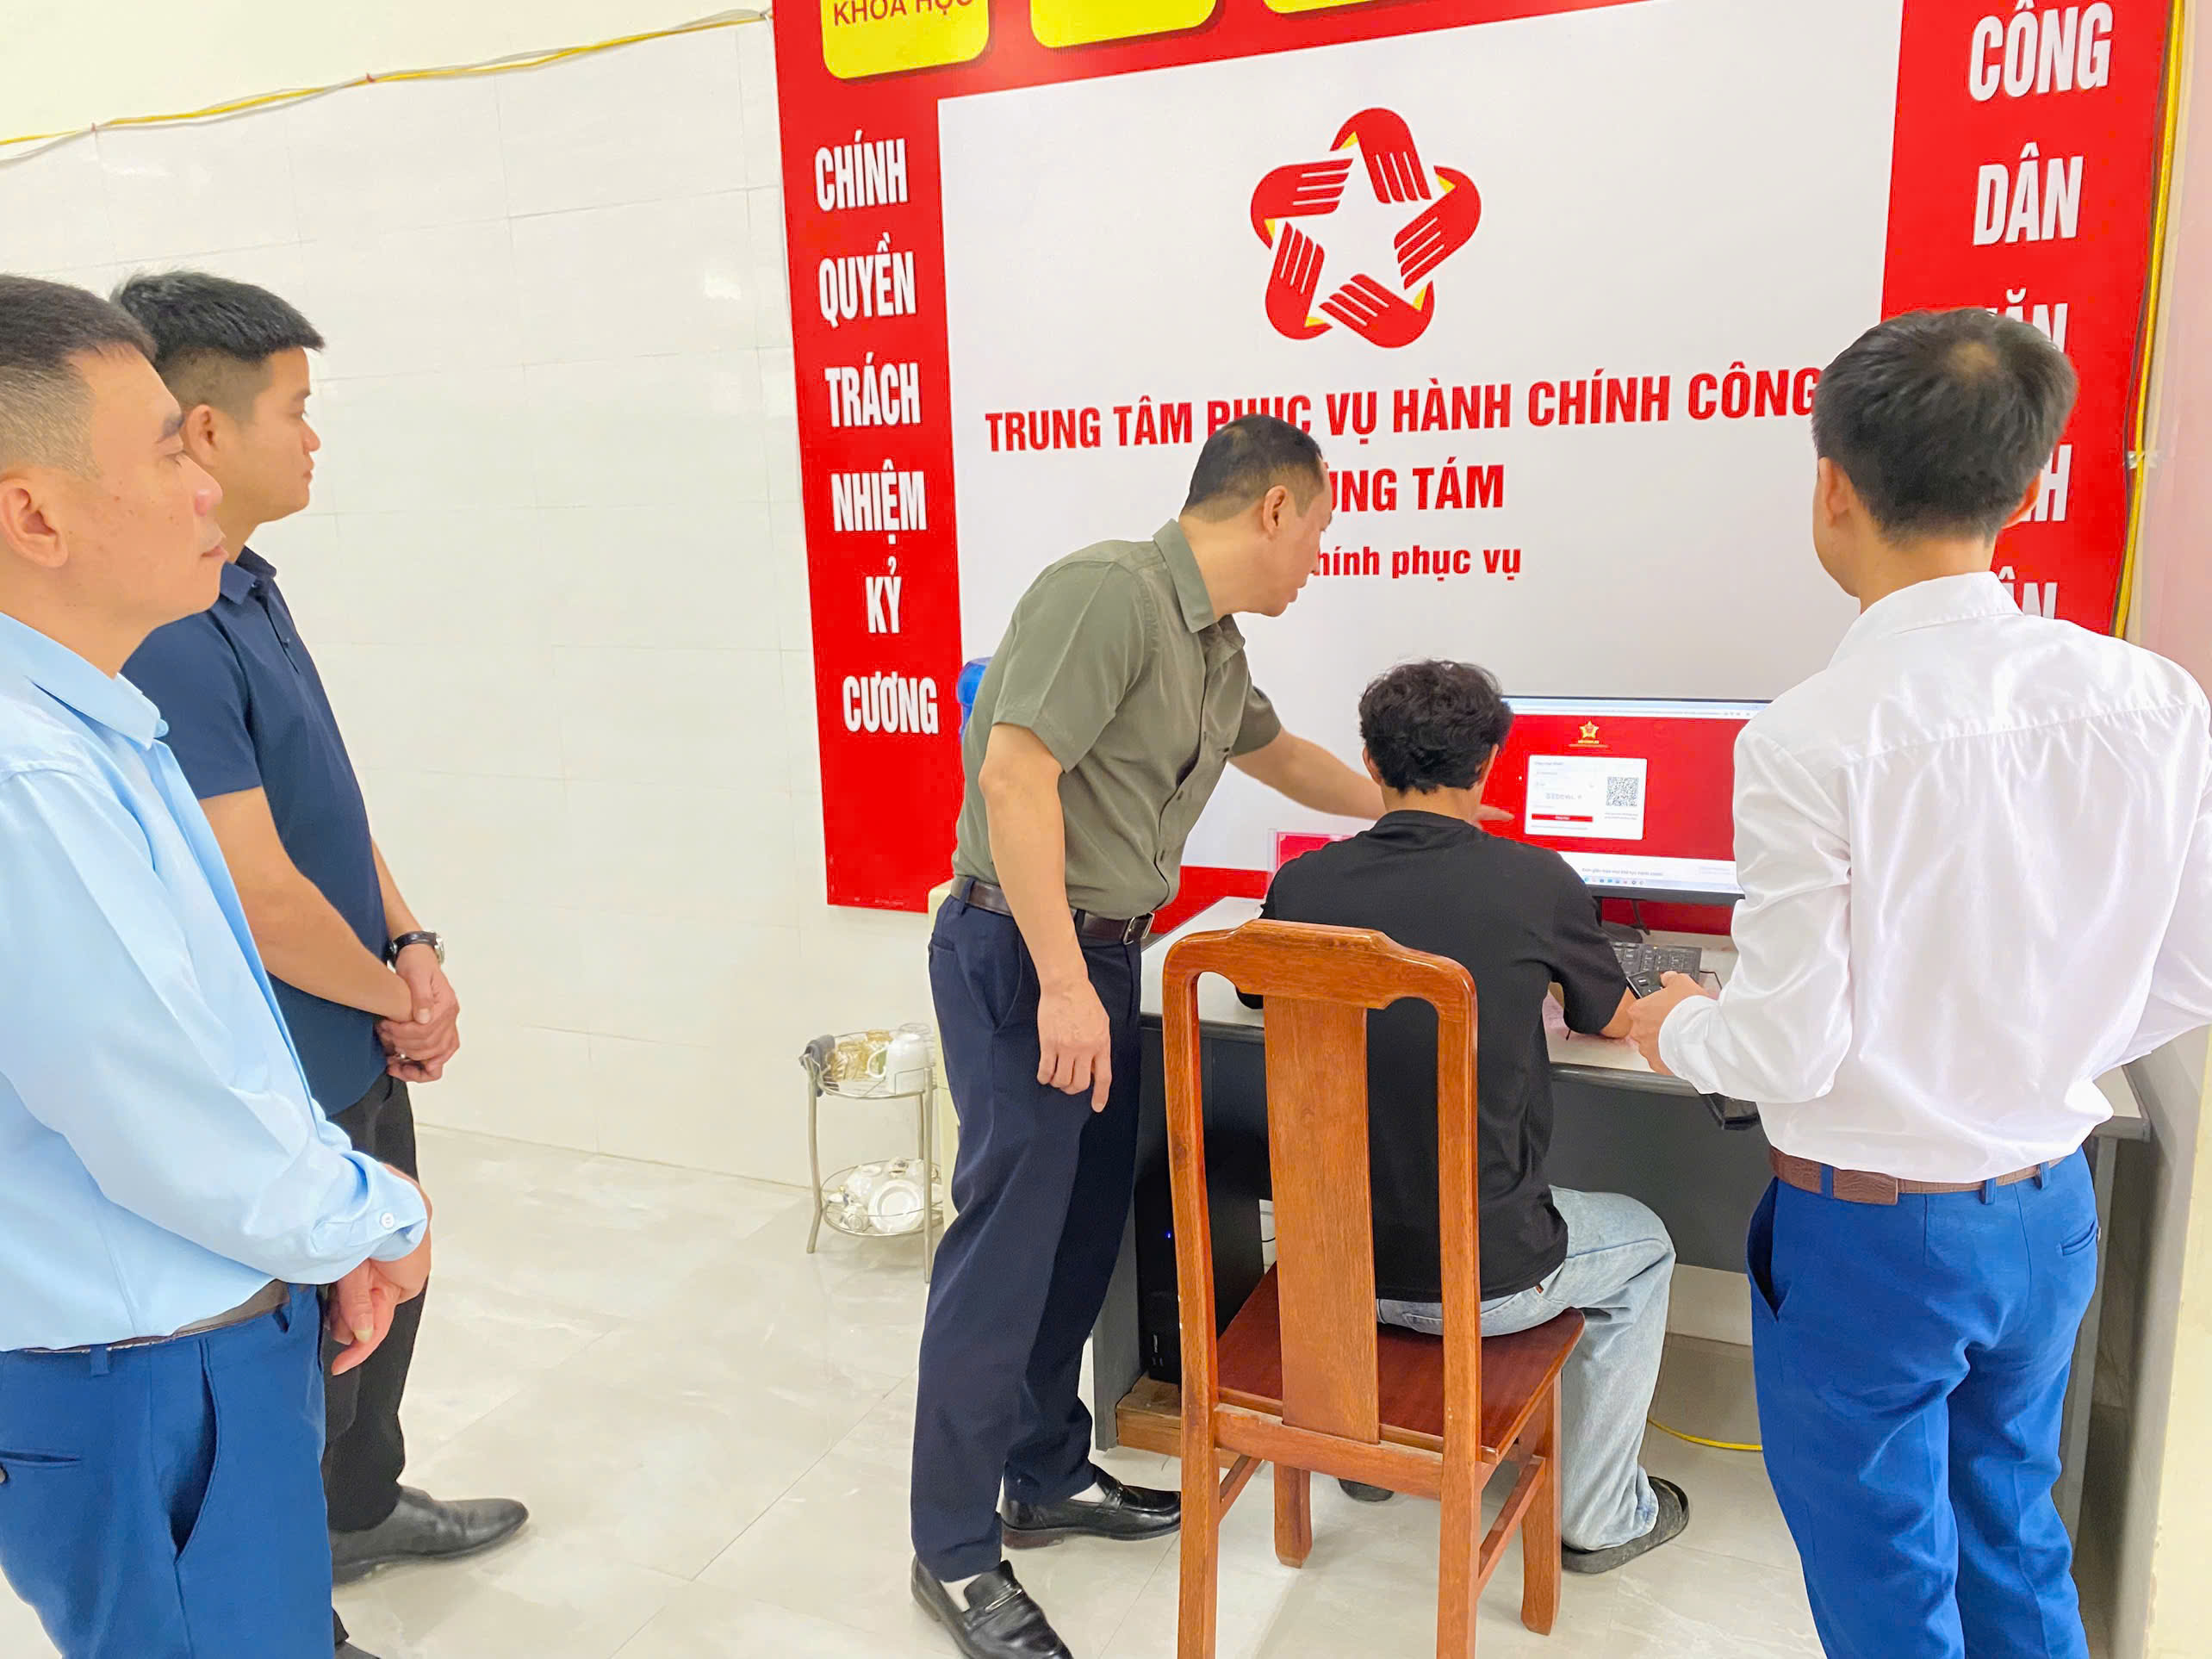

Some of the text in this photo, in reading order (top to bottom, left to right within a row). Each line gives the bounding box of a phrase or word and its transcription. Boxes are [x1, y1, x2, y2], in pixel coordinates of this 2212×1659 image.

[1969, 0, 2113, 101] CÔNG
[815, 130, 908, 212] CHÍNH
[1973, 142, 2084, 245] DÂN
[818, 233, 916, 328] QUYỀN
[824, 351, 921, 427] TRÁCH
[985, 407, 1101, 452] TRUNG
[1113, 395, 1193, 446] TÂM
[1327, 390, 1377, 444] VỤ
[1393, 378, 1512, 433] HÀNH
[1528, 369, 1671, 426] CHÍNH
[1688, 361, 1822, 421] CÔNG
[831, 459, 927, 544] NHIỆM
[1413, 457, 1504, 510] TÁM
[866, 556, 902, 634] KỶ
[1392, 545, 1470, 582] phục
[1483, 549, 1521, 581] vụ
[842, 671, 939, 735] CƯƠNG
